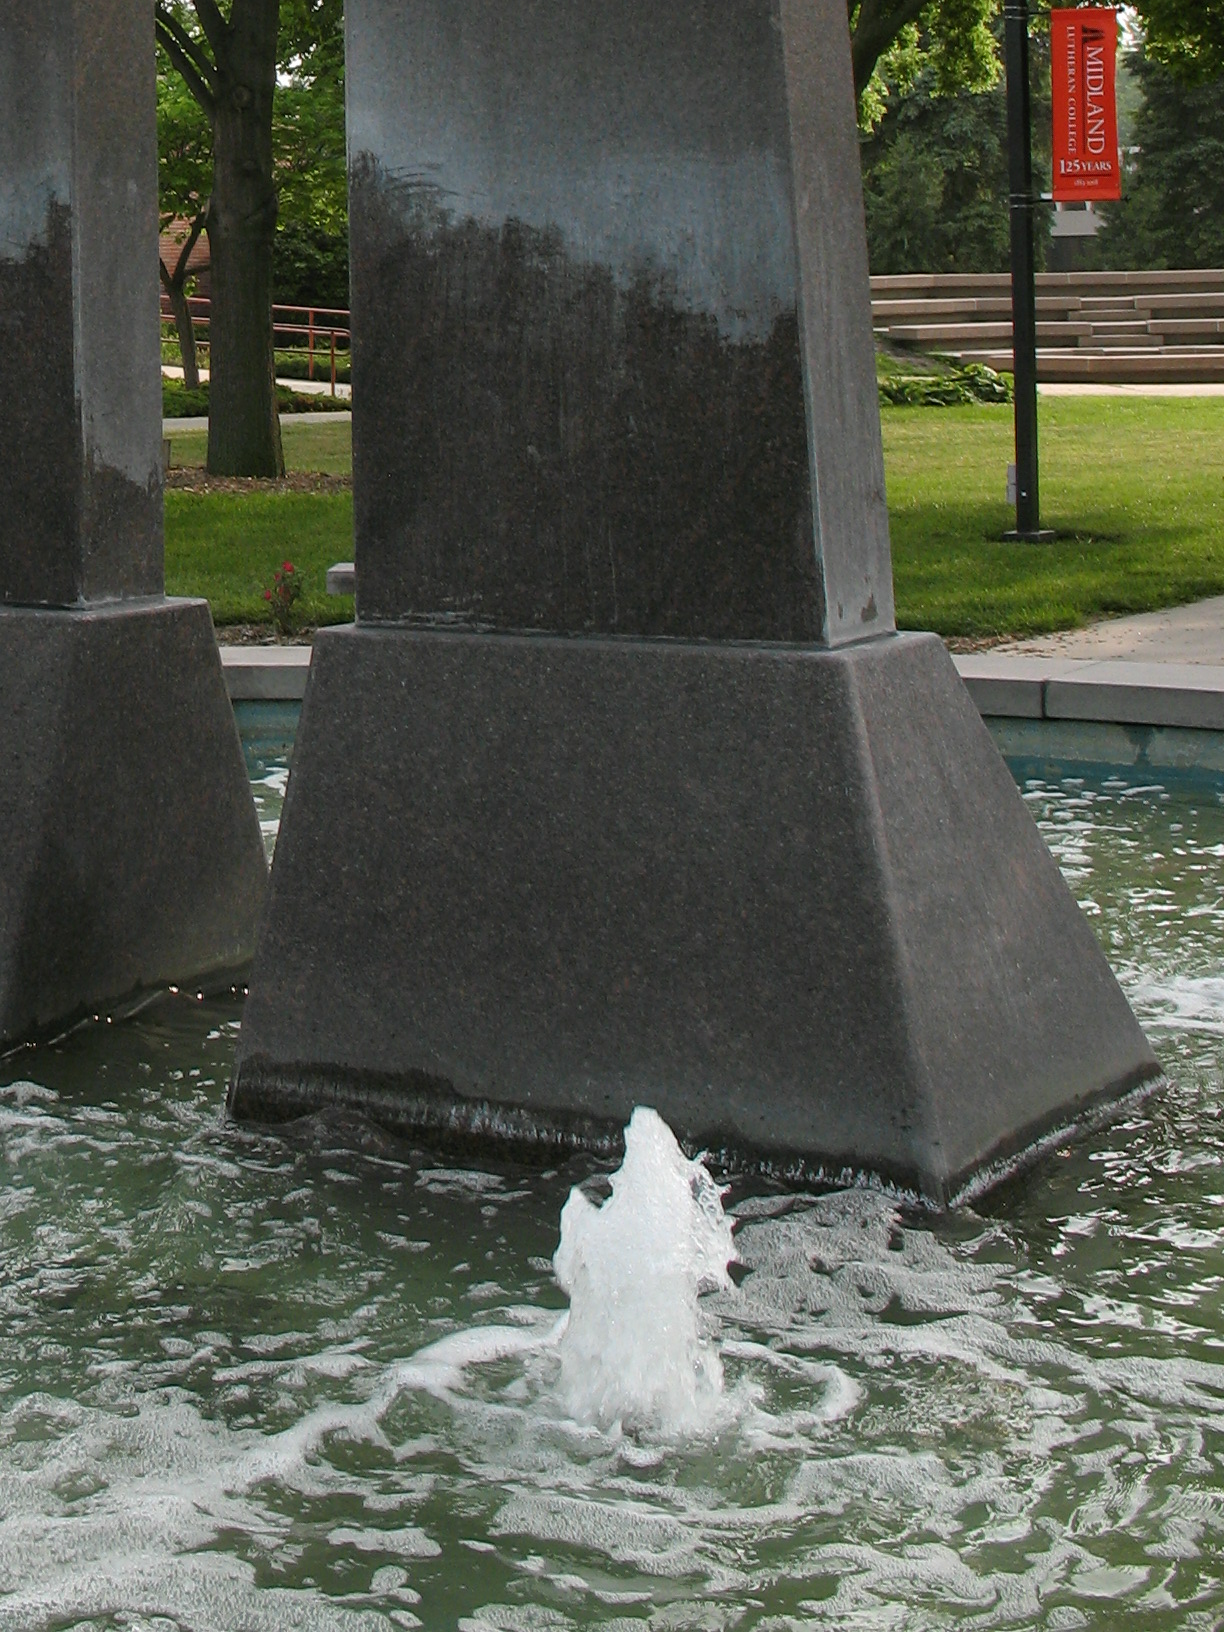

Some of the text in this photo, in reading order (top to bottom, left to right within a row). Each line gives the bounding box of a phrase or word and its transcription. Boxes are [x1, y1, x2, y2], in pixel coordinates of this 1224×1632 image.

[1066, 26, 1077, 155] LUTHERAN COLLEGE
[1086, 46, 1105, 155] MIDLAND
[1060, 158, 1112, 174] 125 YEARS
